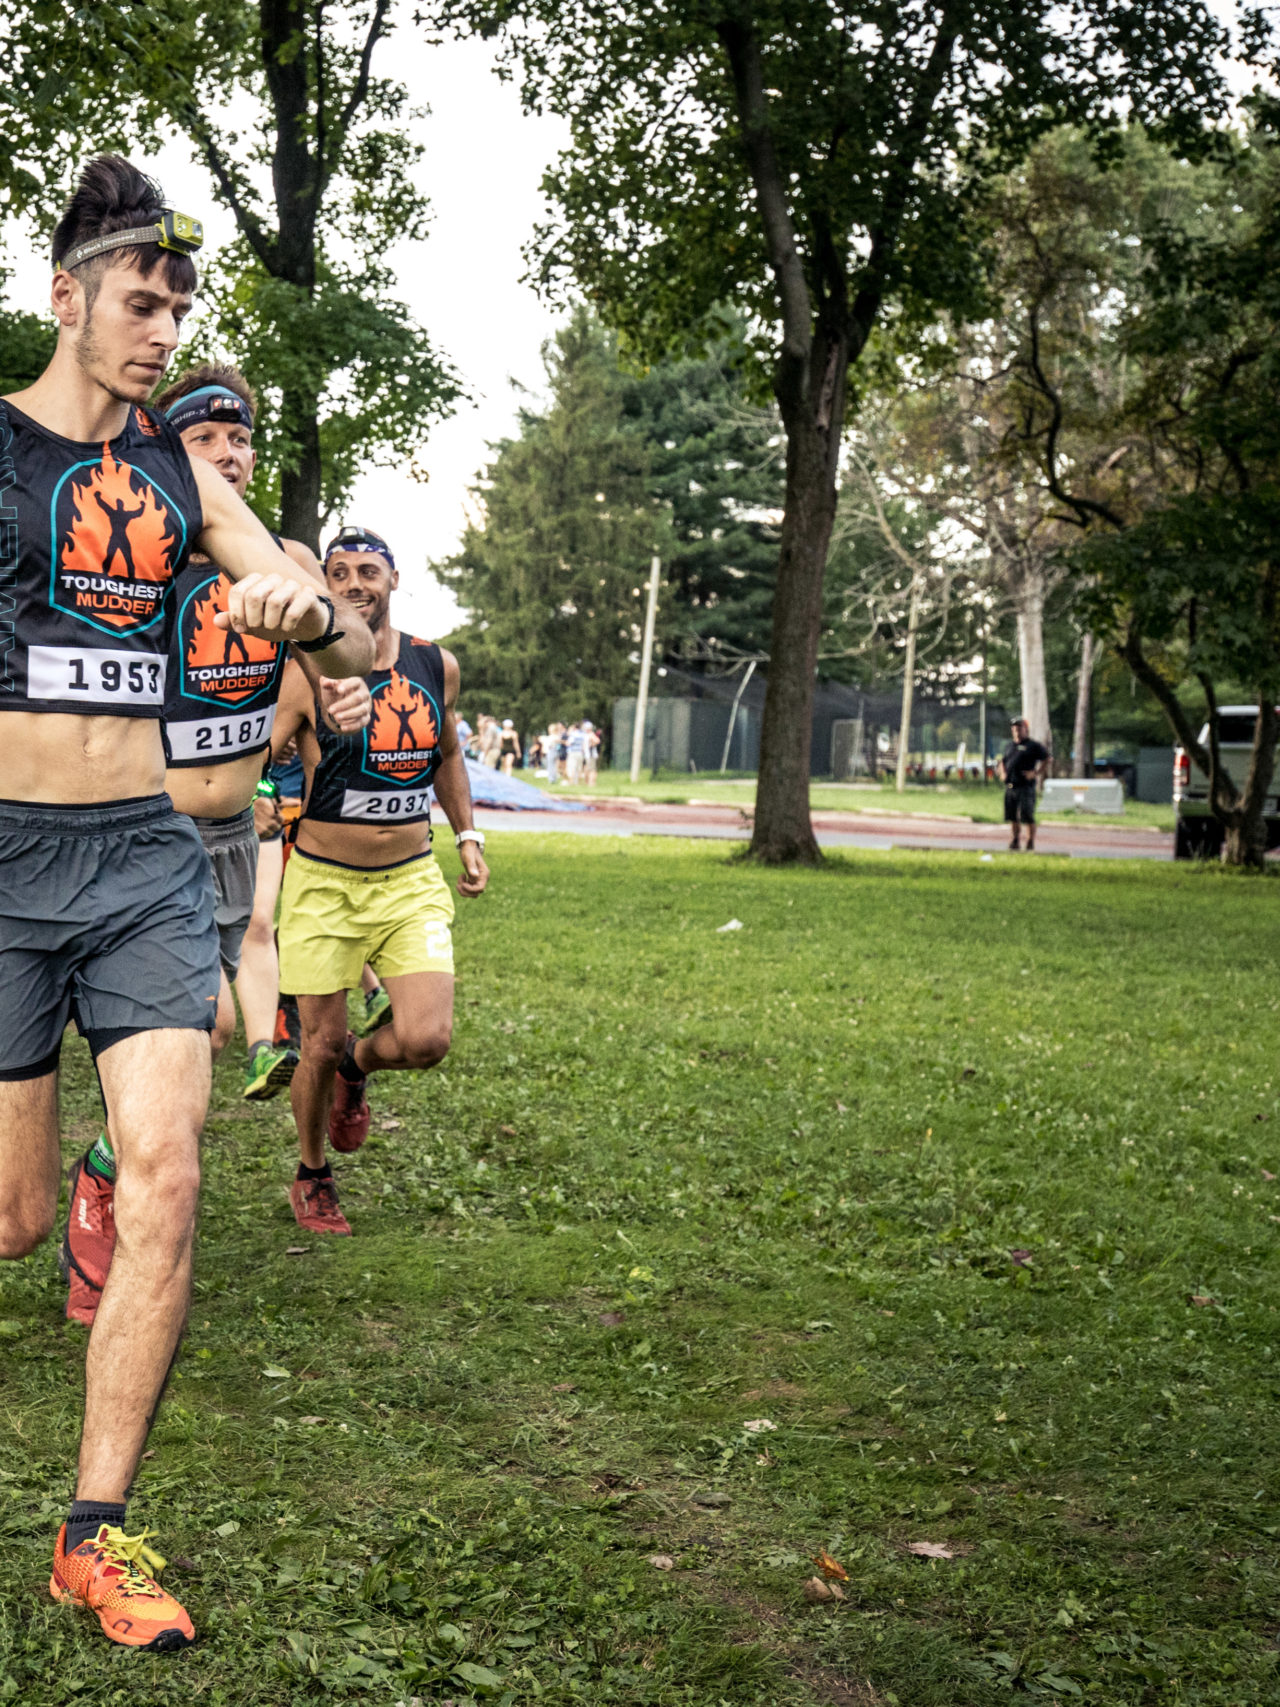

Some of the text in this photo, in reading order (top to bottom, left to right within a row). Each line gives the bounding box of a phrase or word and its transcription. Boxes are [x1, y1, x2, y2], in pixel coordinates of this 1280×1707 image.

[60, 575, 165, 599] TOUGHEST
[75, 592, 155, 615] MUDDER
[68, 658, 161, 694] 1953
[187, 662, 276, 682] TOUGHEST
[200, 675, 267, 692] MUDDER
[195, 715, 267, 751] 2187
[369, 750, 432, 762] TOUGHEST
[377, 760, 428, 771] MUDDER
[366, 793, 428, 814] 2037
